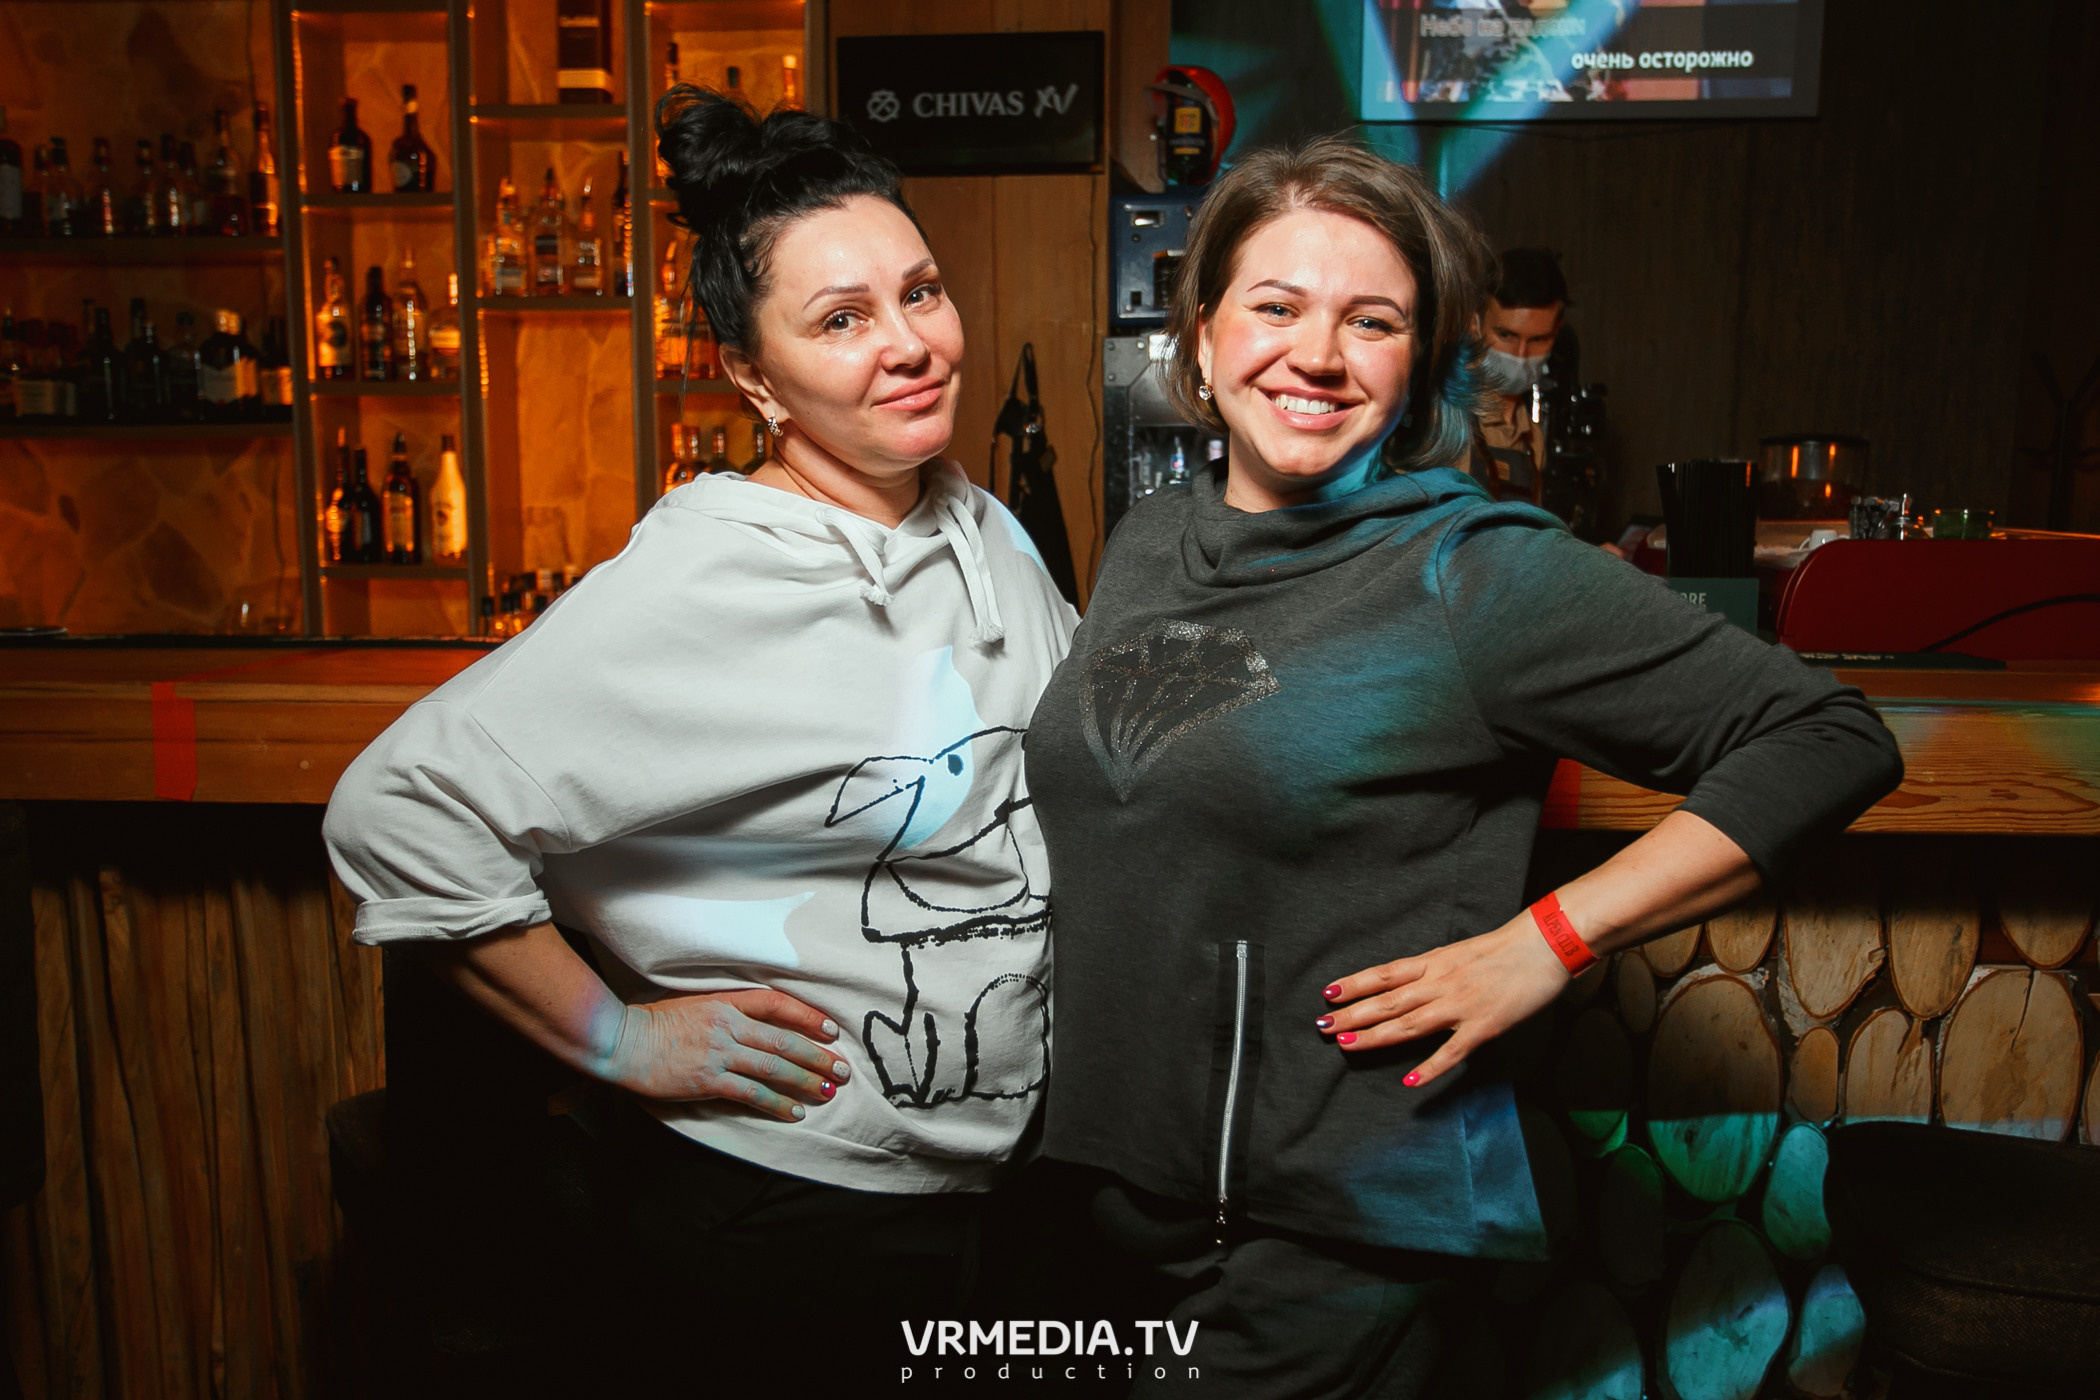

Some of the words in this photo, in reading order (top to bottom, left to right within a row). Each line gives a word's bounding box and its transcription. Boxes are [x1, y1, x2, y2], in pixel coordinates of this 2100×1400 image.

[1571, 52, 1635, 69] очень
[1638, 50, 1754, 73] осторожно
[912, 91, 1025, 118] CHIVAS
